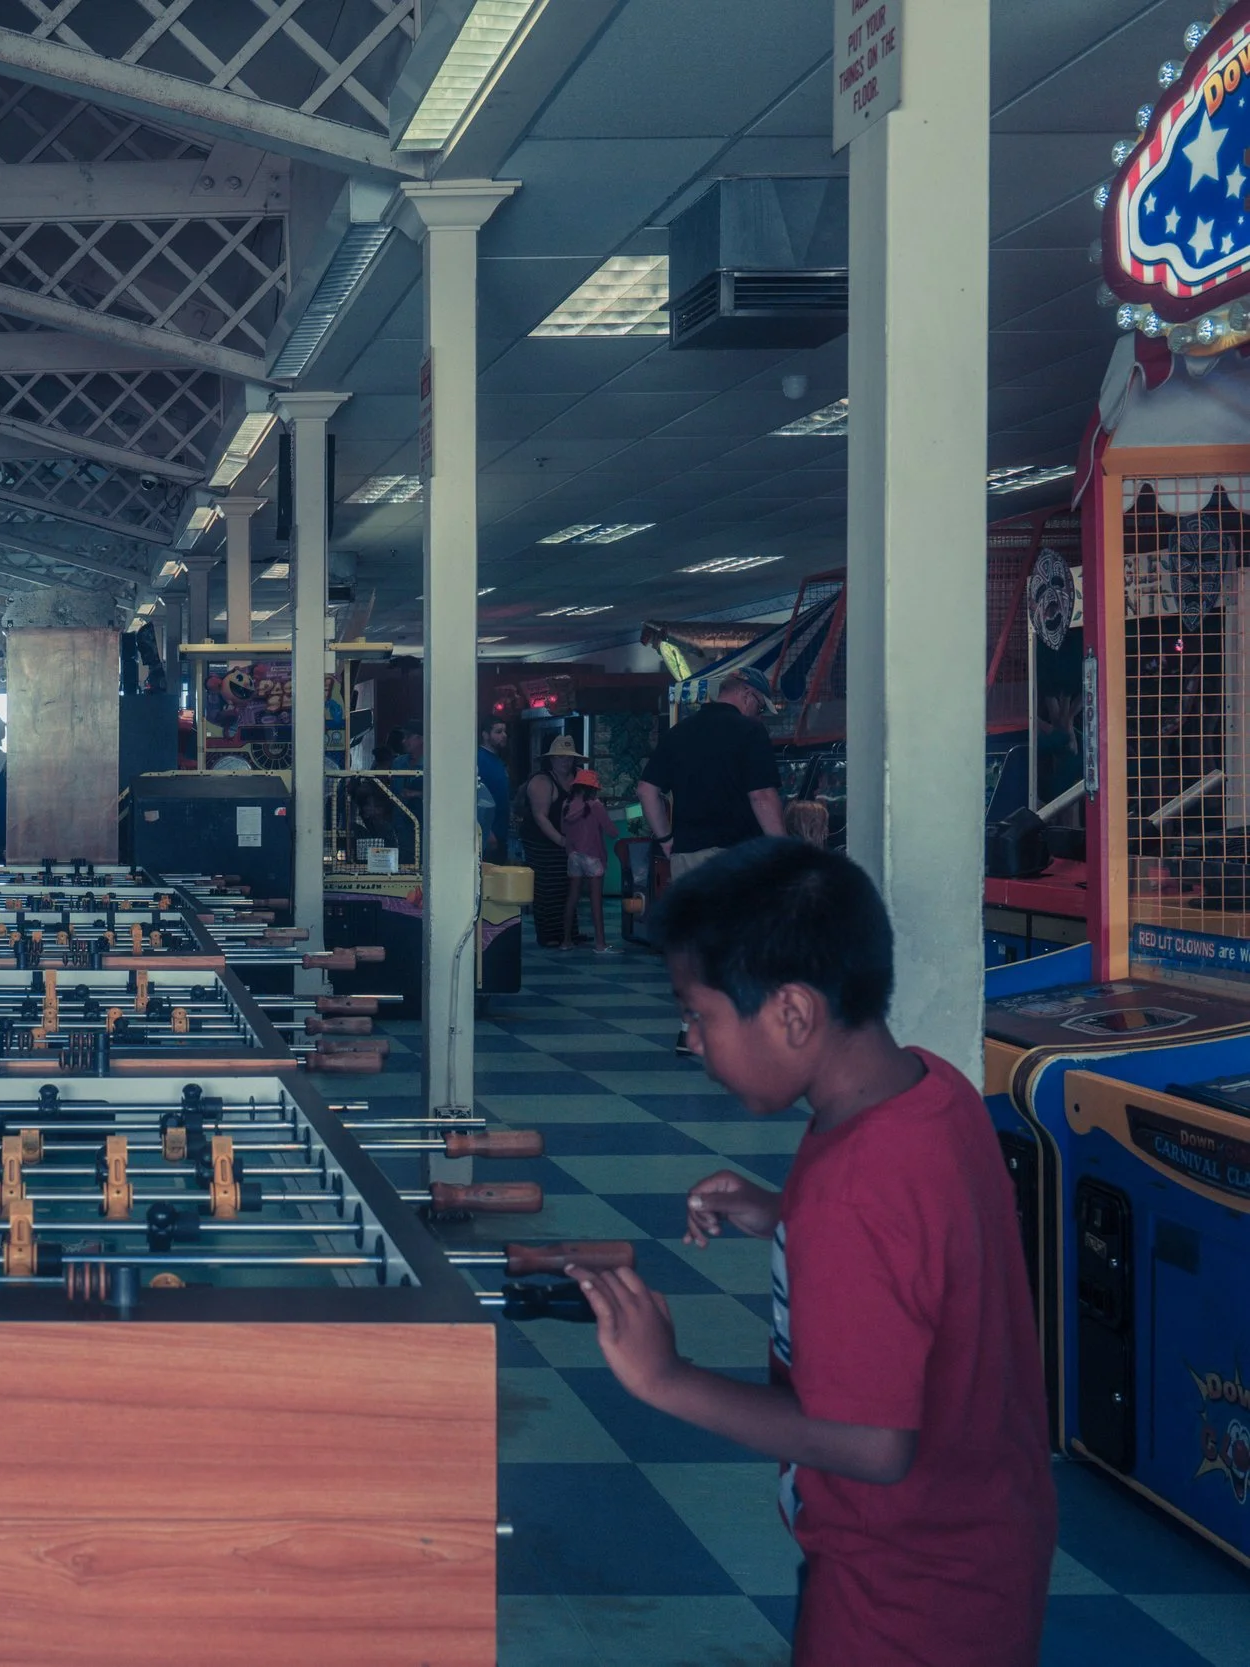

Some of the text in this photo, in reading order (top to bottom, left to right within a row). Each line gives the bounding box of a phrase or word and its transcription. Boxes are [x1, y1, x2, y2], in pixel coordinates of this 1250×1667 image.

[848, 4, 886, 56] PUT YOUR
[839, 27, 895, 95] THINGS ON THE
[853, 76, 879, 114] FLOOR.
[1139, 931, 1156, 948] RED
[1159, 935, 1173, 951] LIT
[1175, 938, 1215, 958] CLOWNS
[1219, 946, 1236, 960] are
[1153, 1135, 1221, 1180] CARNIVAL
